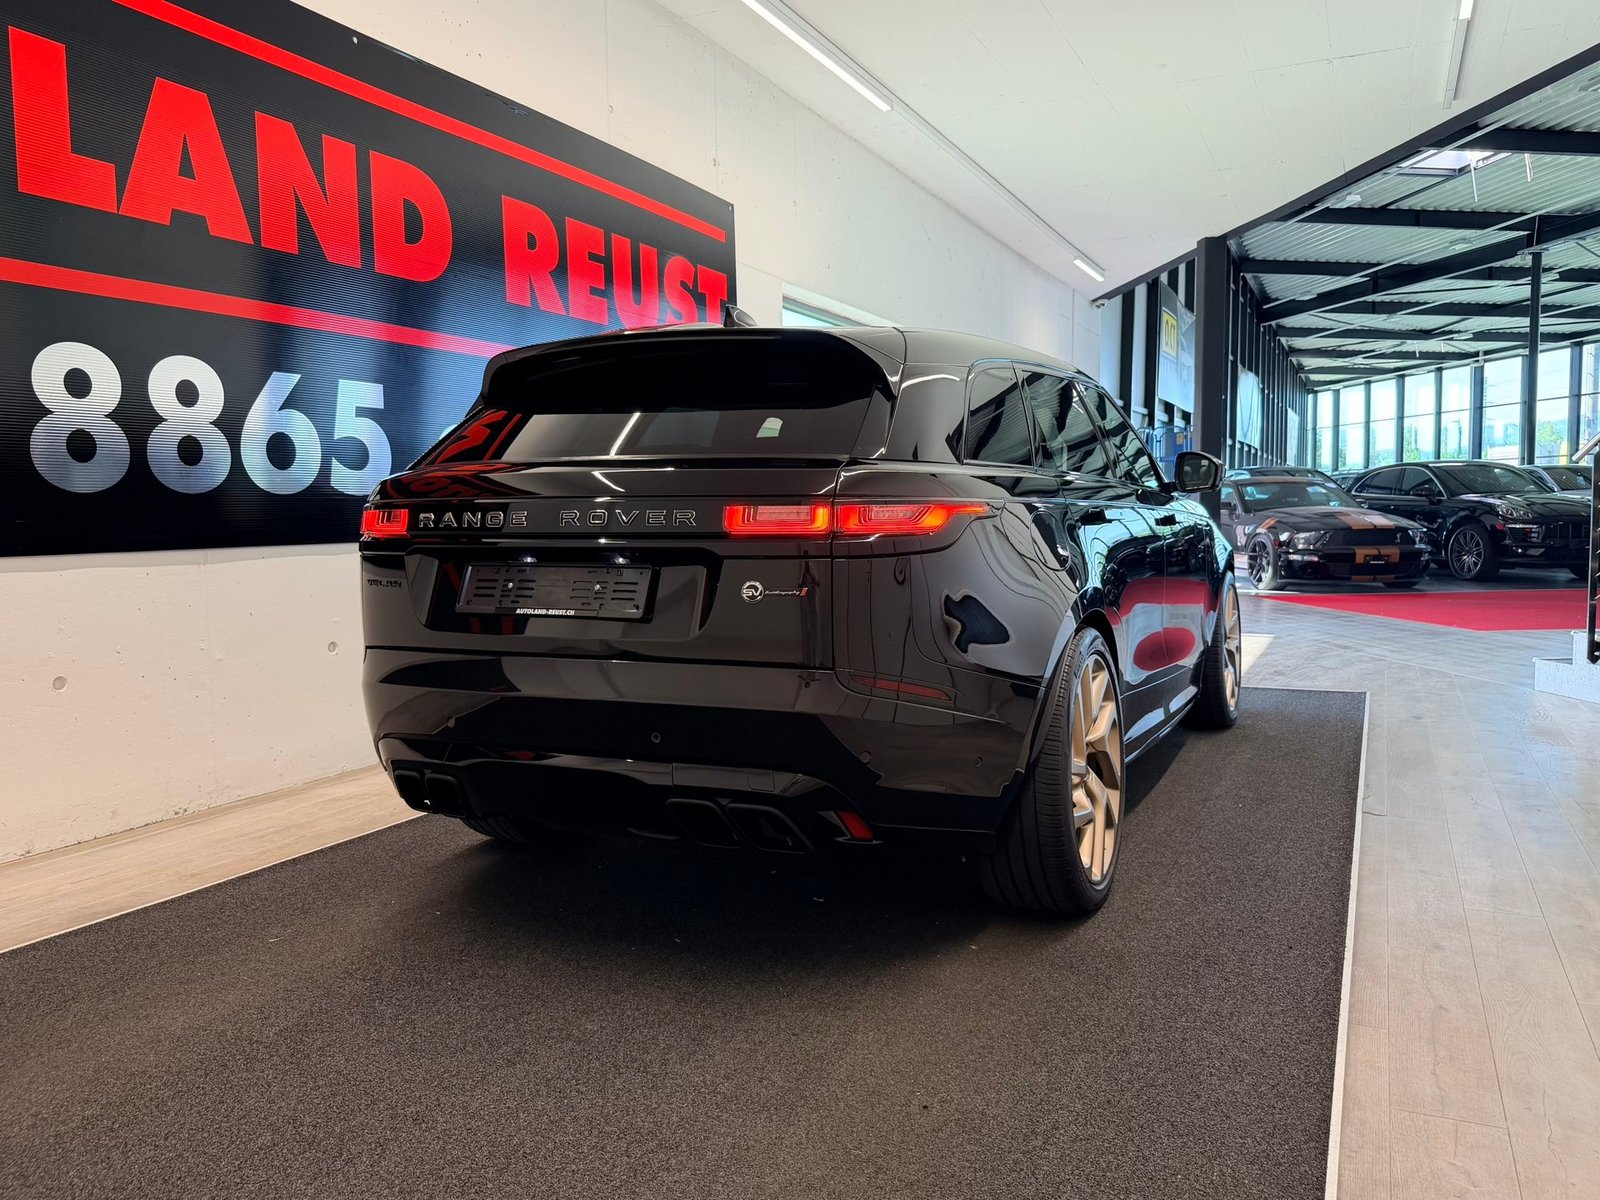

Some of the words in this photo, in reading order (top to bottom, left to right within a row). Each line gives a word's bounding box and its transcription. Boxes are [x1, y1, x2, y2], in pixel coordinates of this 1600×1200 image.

[8, 25, 453, 283] LAND
[501, 194, 728, 331] REUST
[29, 341, 393, 497] 8865
[418, 510, 528, 528] RANGE
[559, 509, 697, 527] ROVER
[515, 608, 576, 616] AUTOLAND-REUST.CH
